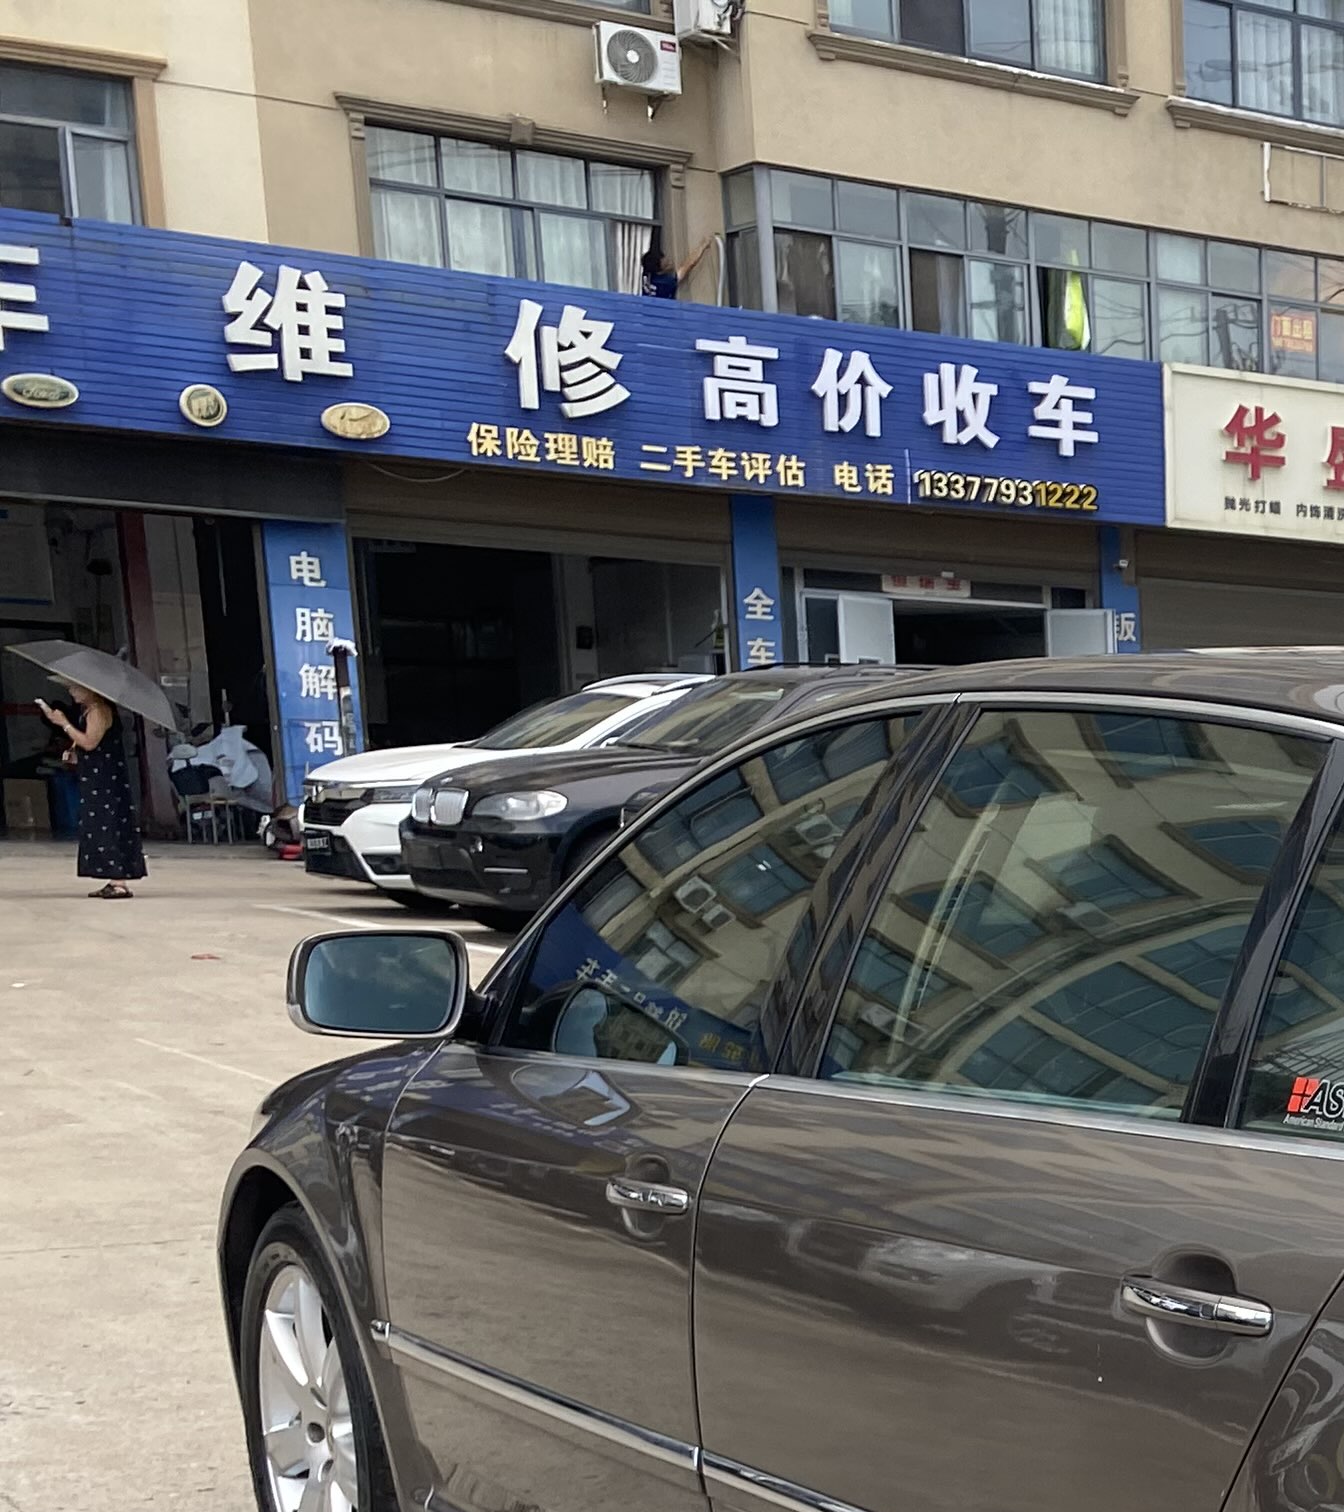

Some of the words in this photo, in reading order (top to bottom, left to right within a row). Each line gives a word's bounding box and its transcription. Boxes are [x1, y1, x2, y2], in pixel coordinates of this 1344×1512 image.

[696, 336, 1099, 457] 高价收车
[467, 422, 616, 470] 保险理赔
[640, 445, 806, 488] 二手车评估
[833, 461, 895, 495] 电话
[915, 470, 1099, 512] 13377931222
